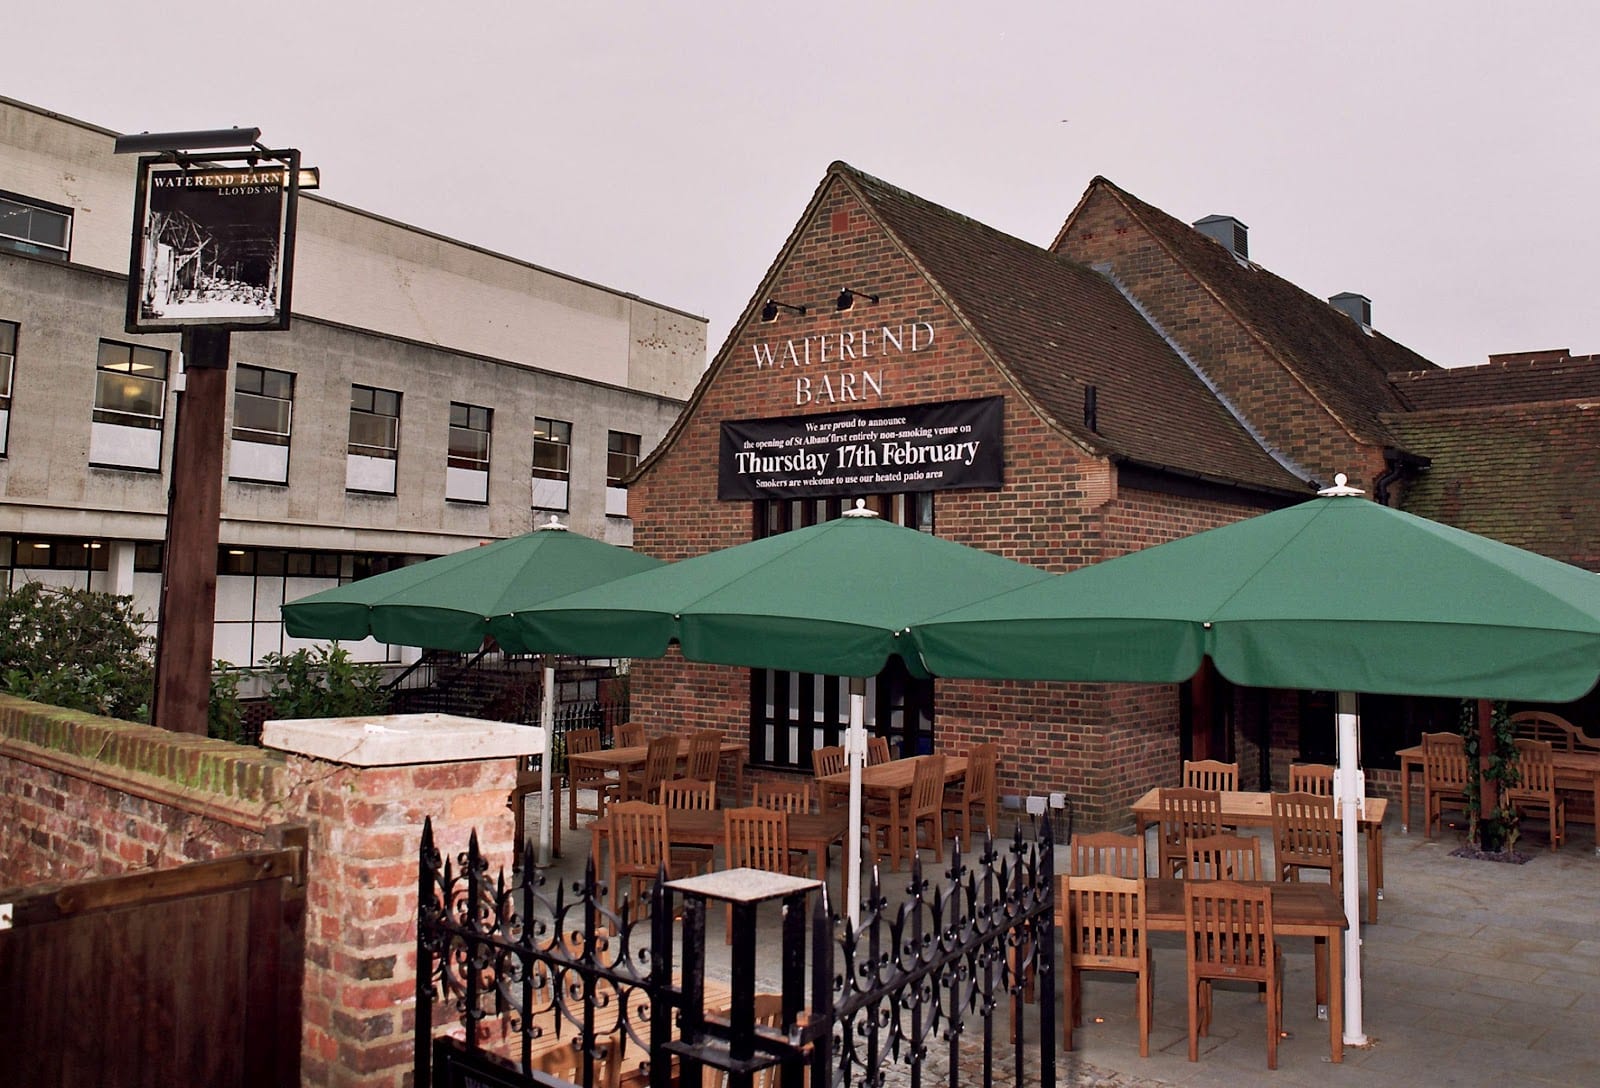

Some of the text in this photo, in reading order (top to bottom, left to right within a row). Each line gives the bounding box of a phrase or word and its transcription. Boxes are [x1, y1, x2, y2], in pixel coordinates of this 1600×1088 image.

[153, 172, 281, 188] WATEREND BARN
[218, 186, 260, 196] LLOYDS
[752, 322, 935, 370] WATEREND
[796, 370, 884, 406] BARN
[805, 416, 907, 432] We are proud to announce
[743, 440, 755, 449] the
[755, 438, 784, 450] opening
[785, 437, 795, 447] of
[794, 436, 803, 446] St
[830, 433, 848, 442] first
[848, 430, 879, 442] entirely
[880, 427, 933, 439] non-smoking
[934, 425, 958, 435] venue
[960, 424, 972, 433] on
[735, 440, 981, 476] Thursday 17th February
[755, 470, 943, 488] Smokers are welcome to use our heated patio area
